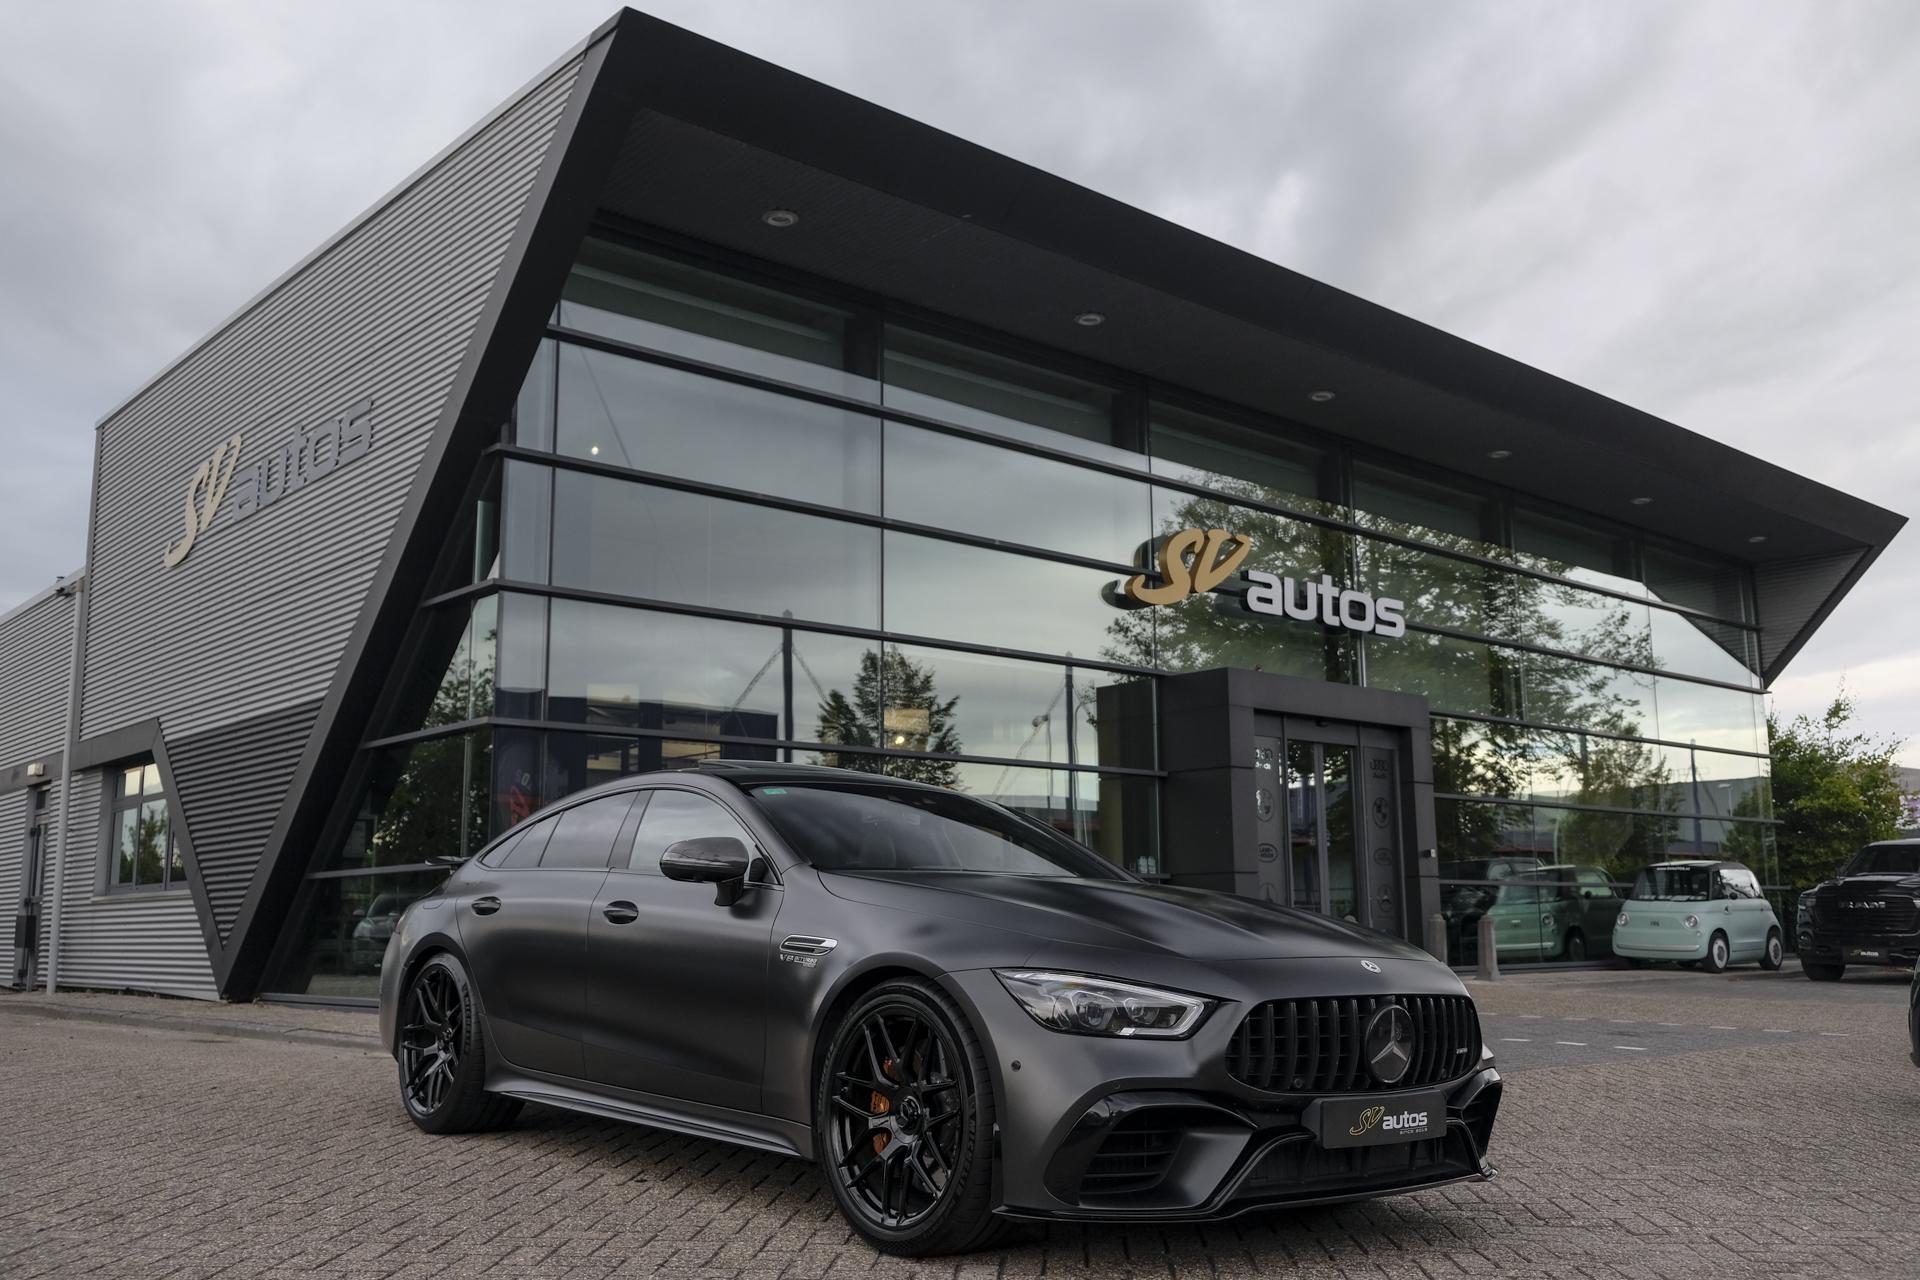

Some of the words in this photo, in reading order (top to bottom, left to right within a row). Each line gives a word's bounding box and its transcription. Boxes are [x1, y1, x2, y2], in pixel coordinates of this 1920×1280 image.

[163, 433, 241, 568] SV
[232, 397, 373, 522] autos
[1125, 528, 1251, 605] SV
[1246, 570, 1405, 638] autos
[1349, 1105, 1385, 1136] SV
[1382, 1110, 1428, 1130] autos
